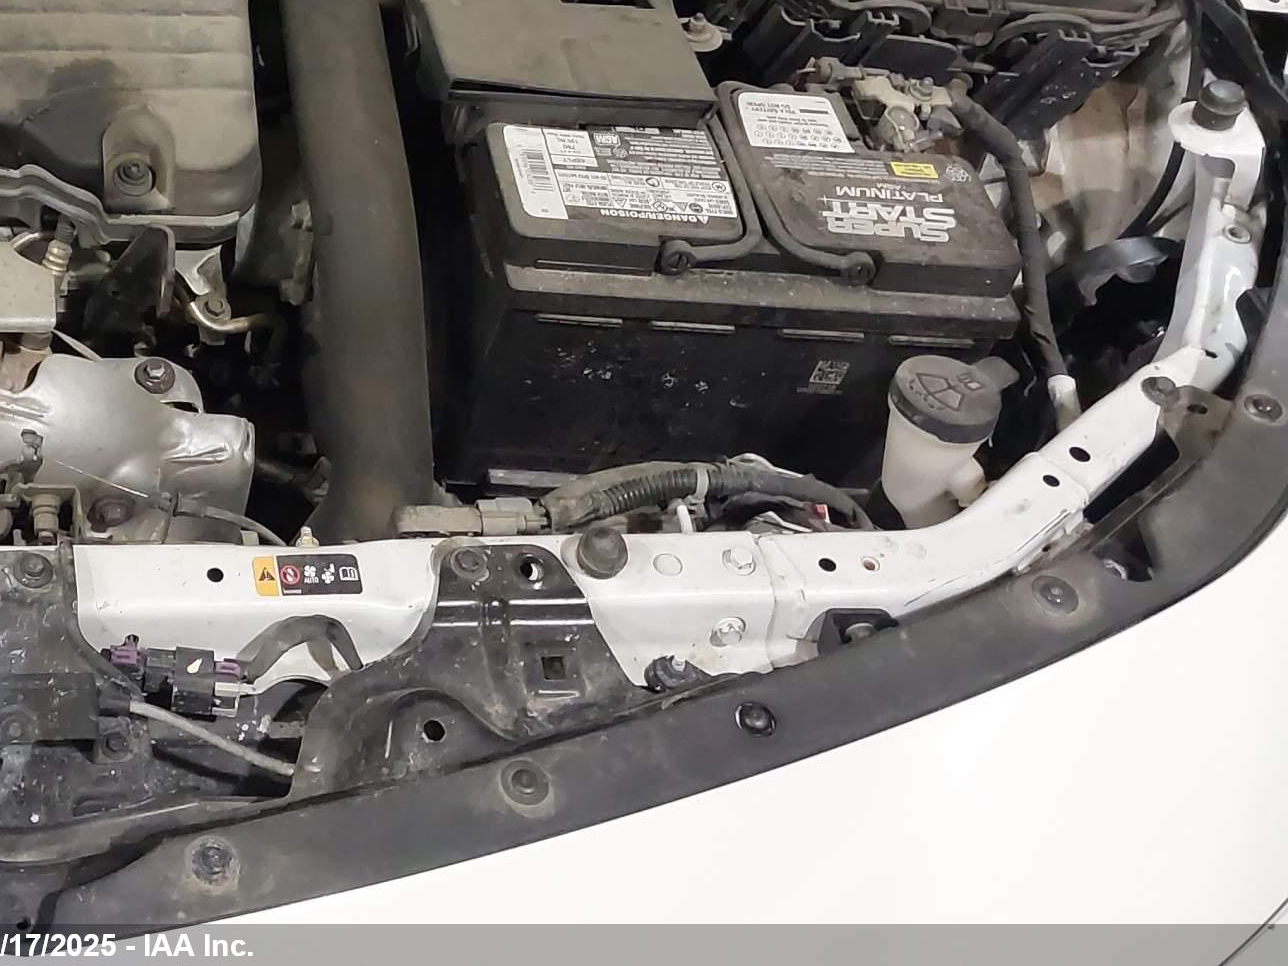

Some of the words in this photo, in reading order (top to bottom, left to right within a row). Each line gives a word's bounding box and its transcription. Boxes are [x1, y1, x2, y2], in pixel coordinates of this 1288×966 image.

[836, 186, 943, 203] PLATINUM
[822, 200, 957, 229] START
[827, 216, 950, 243] SUPER
[304, 576, 319, 584] AUTO
